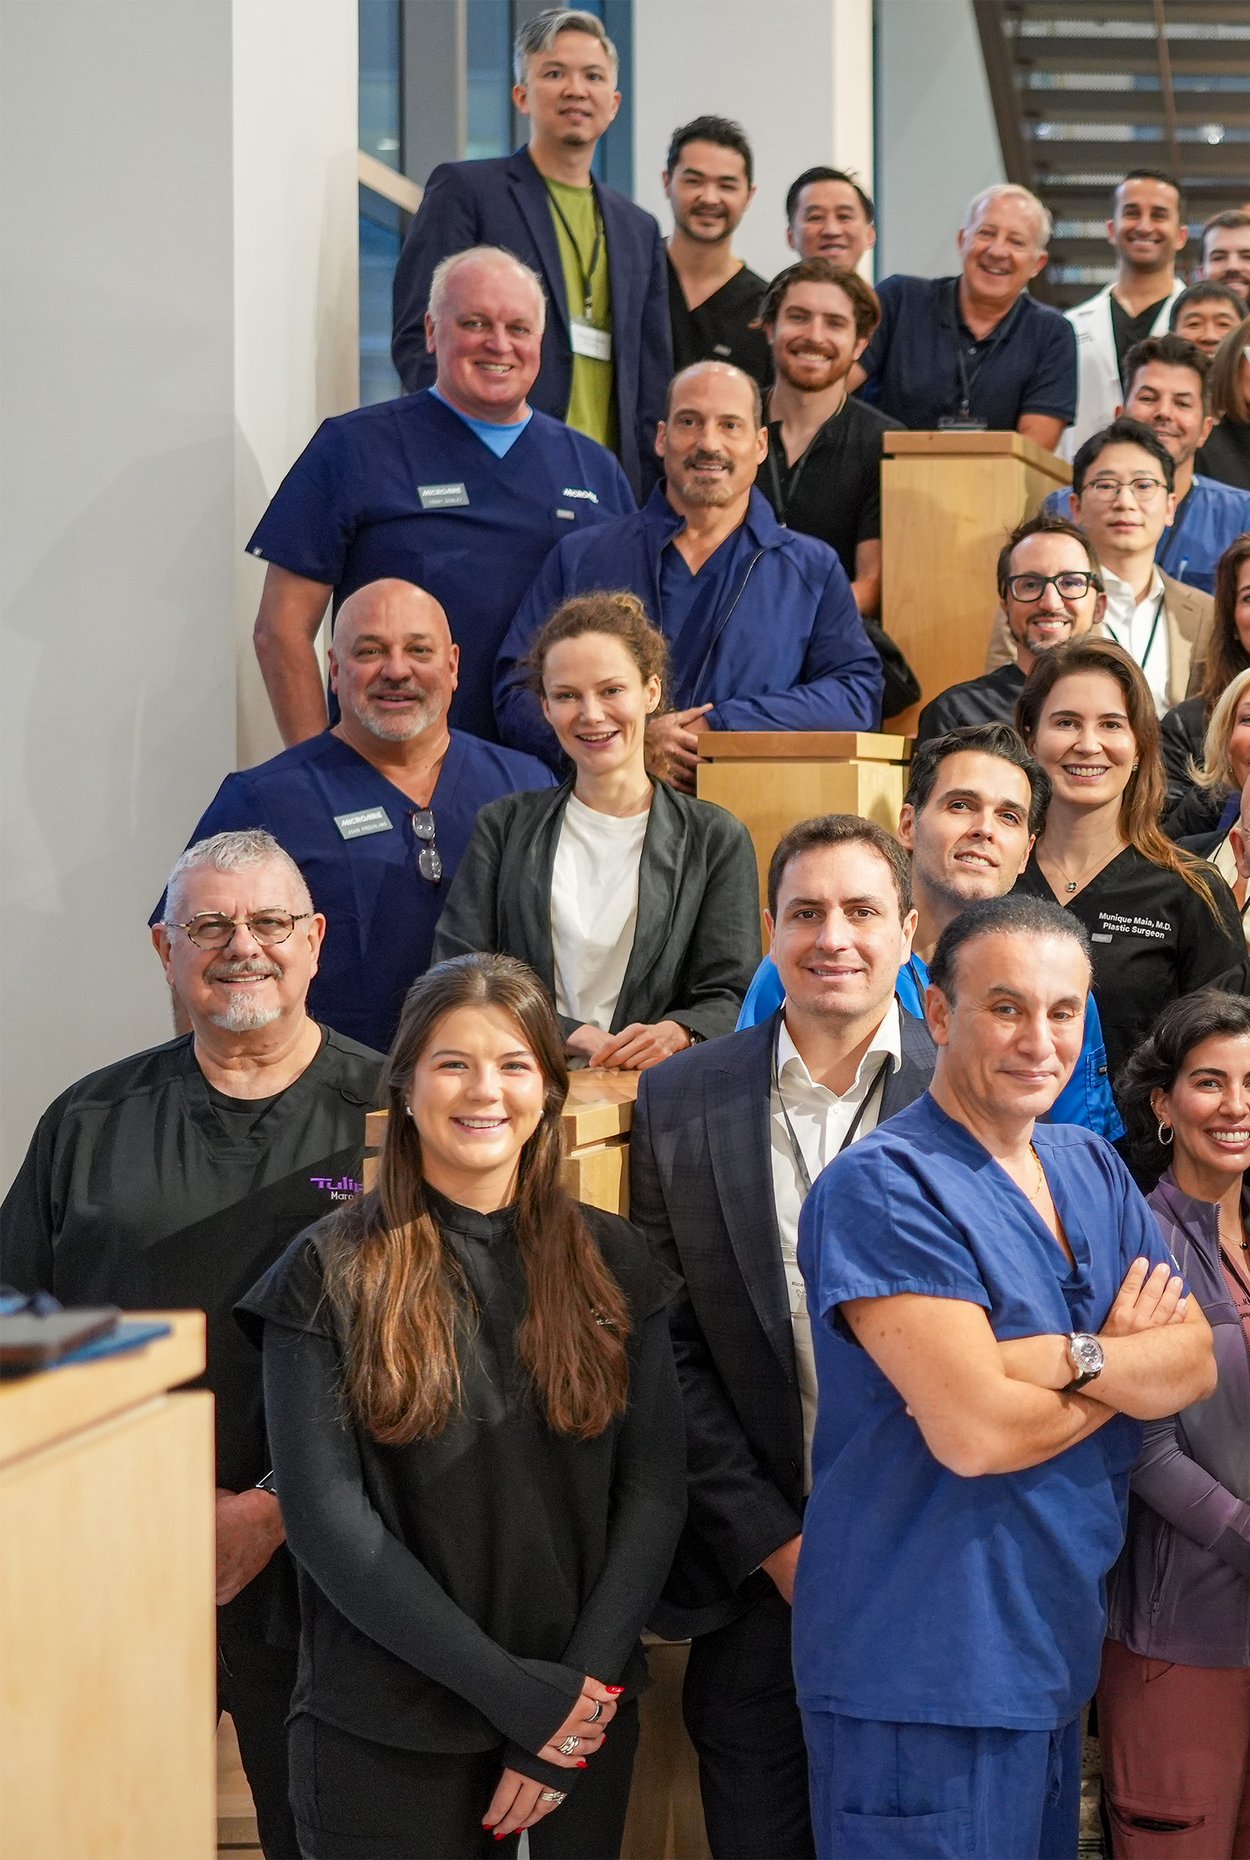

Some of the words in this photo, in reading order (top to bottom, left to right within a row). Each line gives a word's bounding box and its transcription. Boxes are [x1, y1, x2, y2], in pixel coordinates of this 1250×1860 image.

[1099, 912, 1132, 924] Munique
[1133, 917, 1154, 928] Maia,
[1155, 921, 1172, 931] M.D.
[1103, 922, 1130, 933] Plastic
[1131, 925, 1165, 939] Surgeon
